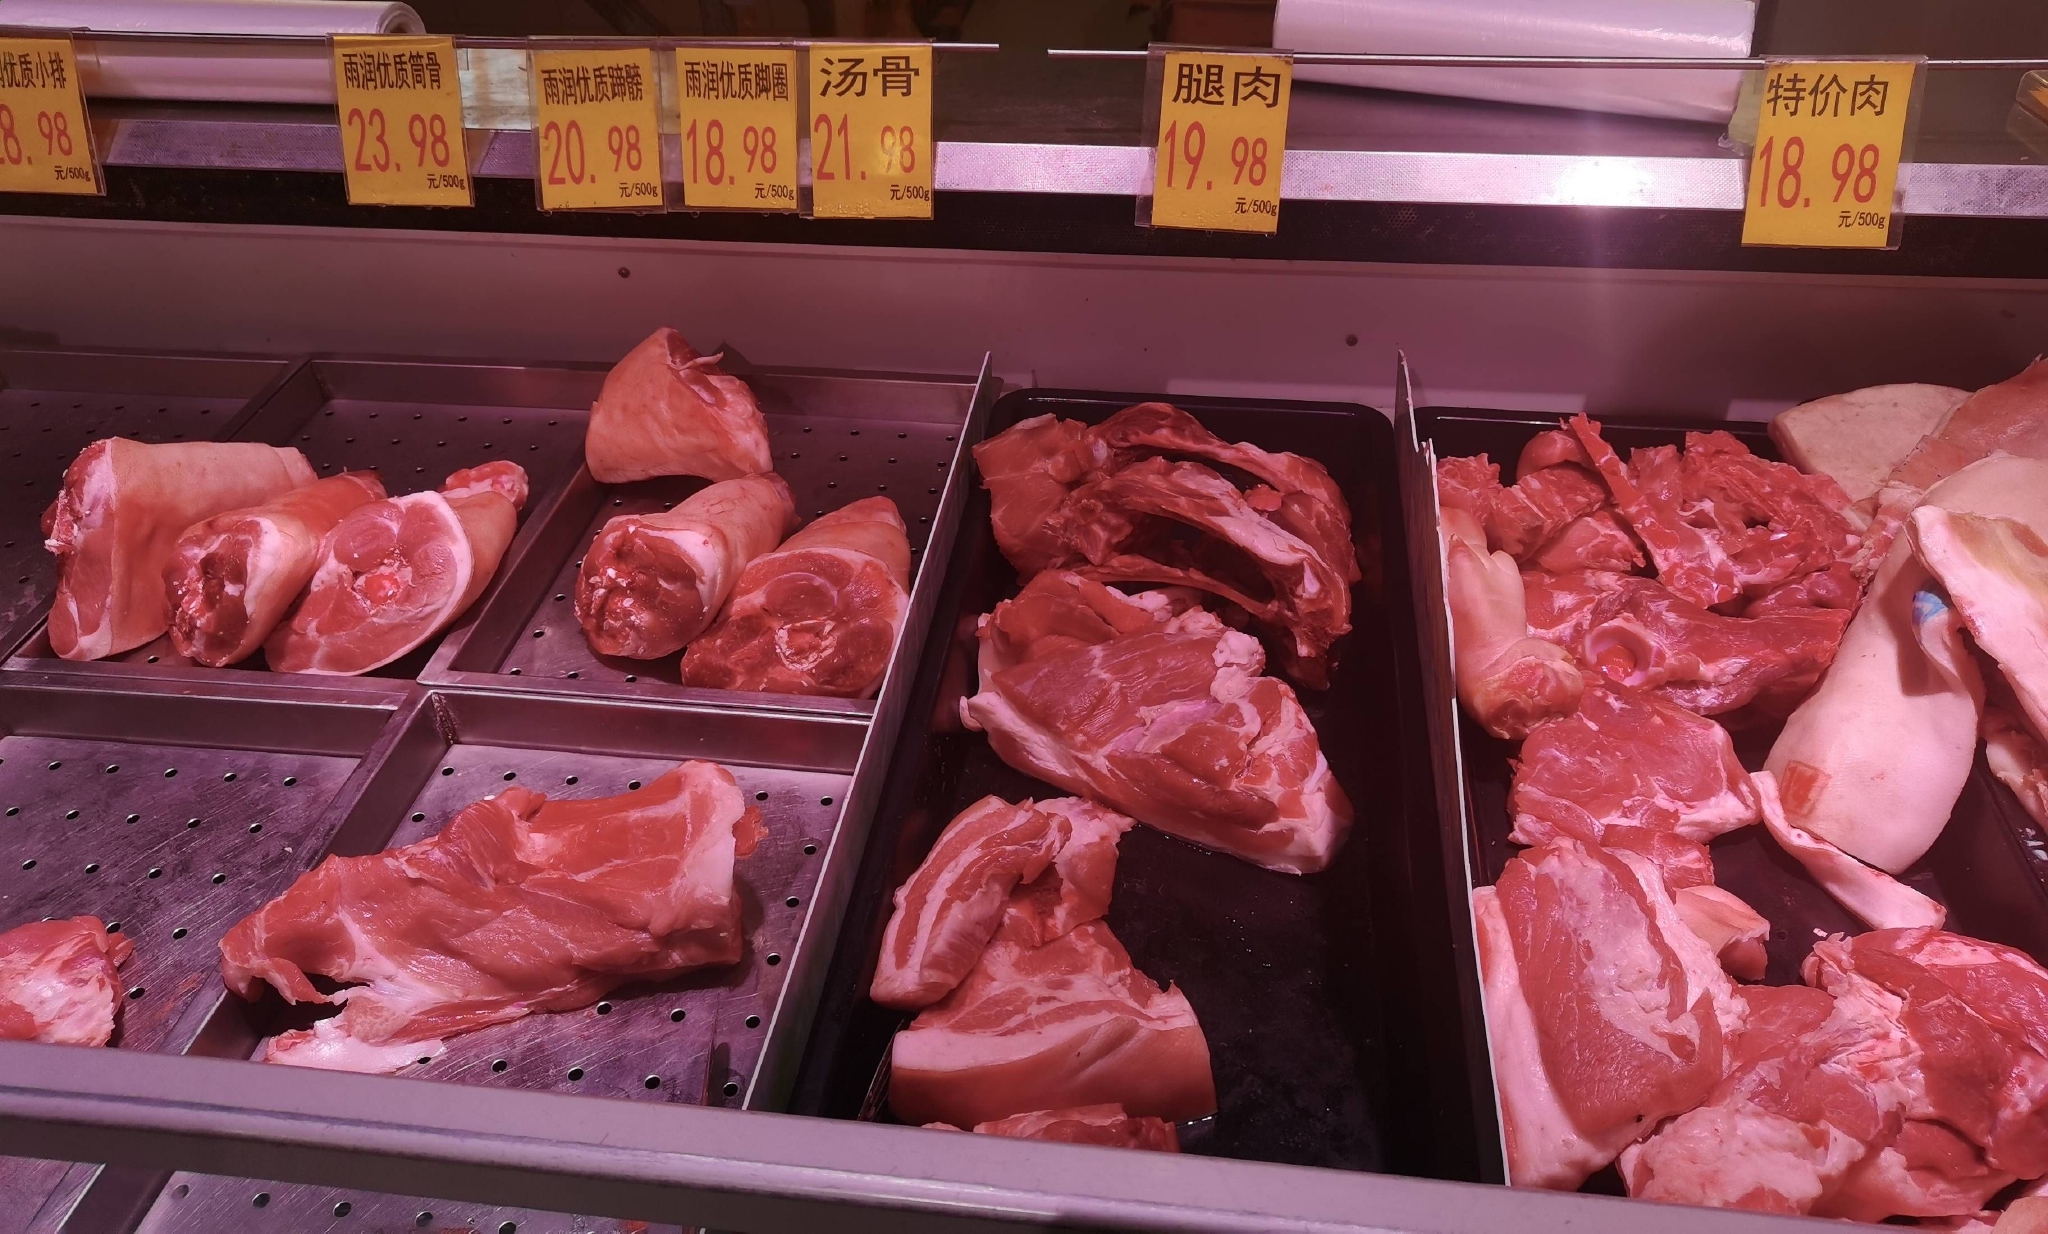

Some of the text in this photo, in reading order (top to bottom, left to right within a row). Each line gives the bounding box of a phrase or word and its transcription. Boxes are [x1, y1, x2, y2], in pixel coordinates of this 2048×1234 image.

[342, 51, 441, 90] 雨润优质筒骨
[684, 60, 789, 101] 雨润优质脚圈
[820, 56, 920, 97] 汤骨
[1172, 63, 1281, 108] 腿肉
[1767, 73, 1889, 117] 特价肉
[0, 103, 73, 165] 8.98
[348, 107, 450, 173] 23.98
[544, 119, 643, 186] 20.98
[687, 118, 777, 186] 18.98
[813, 113, 916, 181] 21.98
[54, 165, 91, 182] 元/500g
[1165, 120, 1267, 191] 19.98
[1759, 135, 1880, 208] 18.98
[427, 173, 466, 190] 元/500g
[619, 182, 658, 198] 元/500g
[755, 183, 795, 200] 元/500g
[890, 184, 930, 201] 元/500g
[1235, 197, 1277, 217] 元/500g
[1838, 210, 1886, 230] 元/500g
